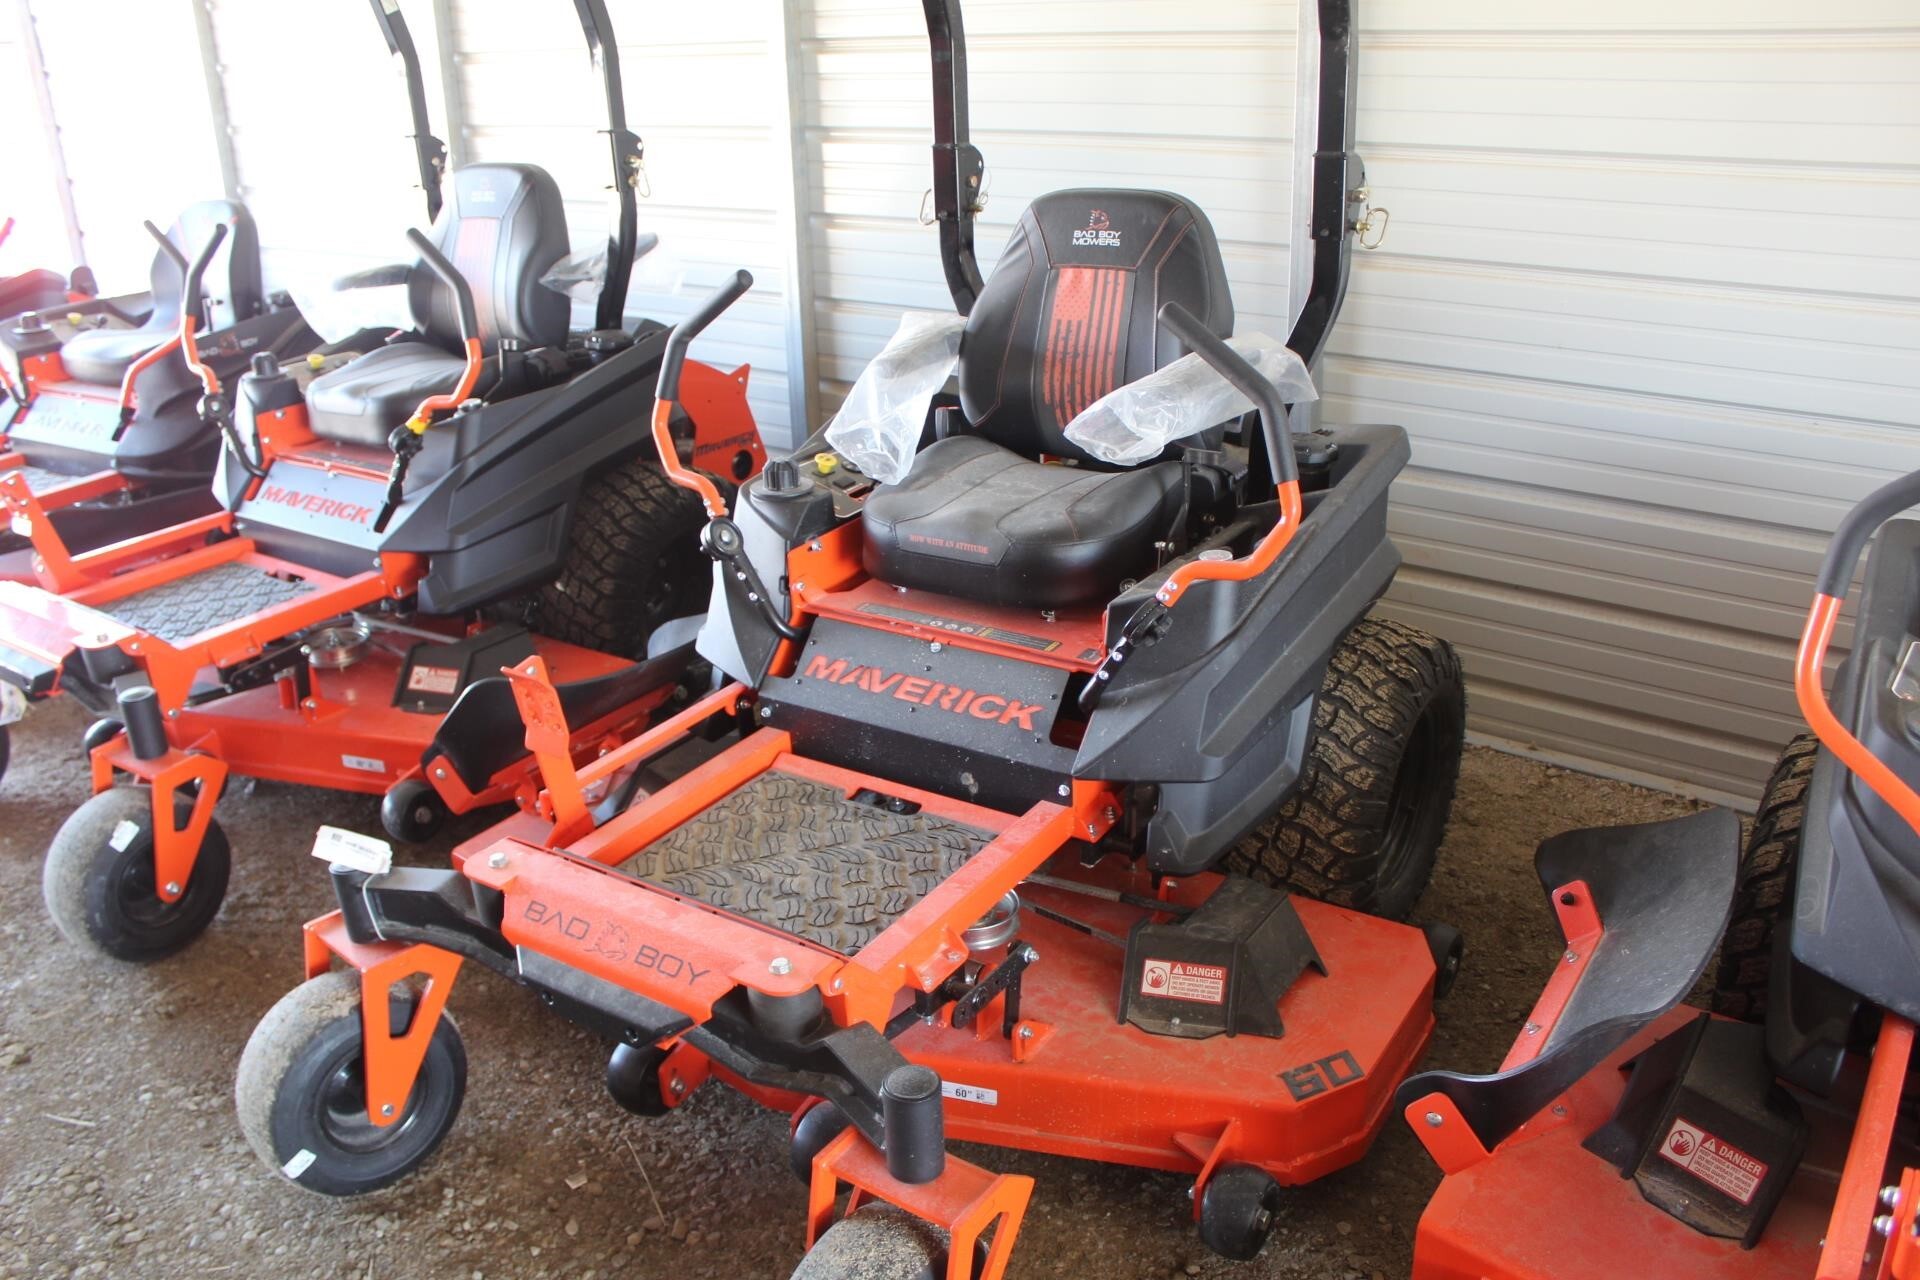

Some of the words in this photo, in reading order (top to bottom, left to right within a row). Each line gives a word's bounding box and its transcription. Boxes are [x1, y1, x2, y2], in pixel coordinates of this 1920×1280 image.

[1072, 237, 1121, 247] MOWERS
[1073, 230, 1096, 238] BAD
[1098, 230, 1121, 239] BOY
[261, 484, 374, 525] MAVERICK
[804, 654, 1045, 731] MAVERICK
[524, 900, 591, 940] BAD
[634, 944, 712, 985] BOY
[1186, 966, 1222, 978] DANGER
[1277, 1049, 1365, 1102] 60
[1718, 1145, 1762, 1175] DANGER
